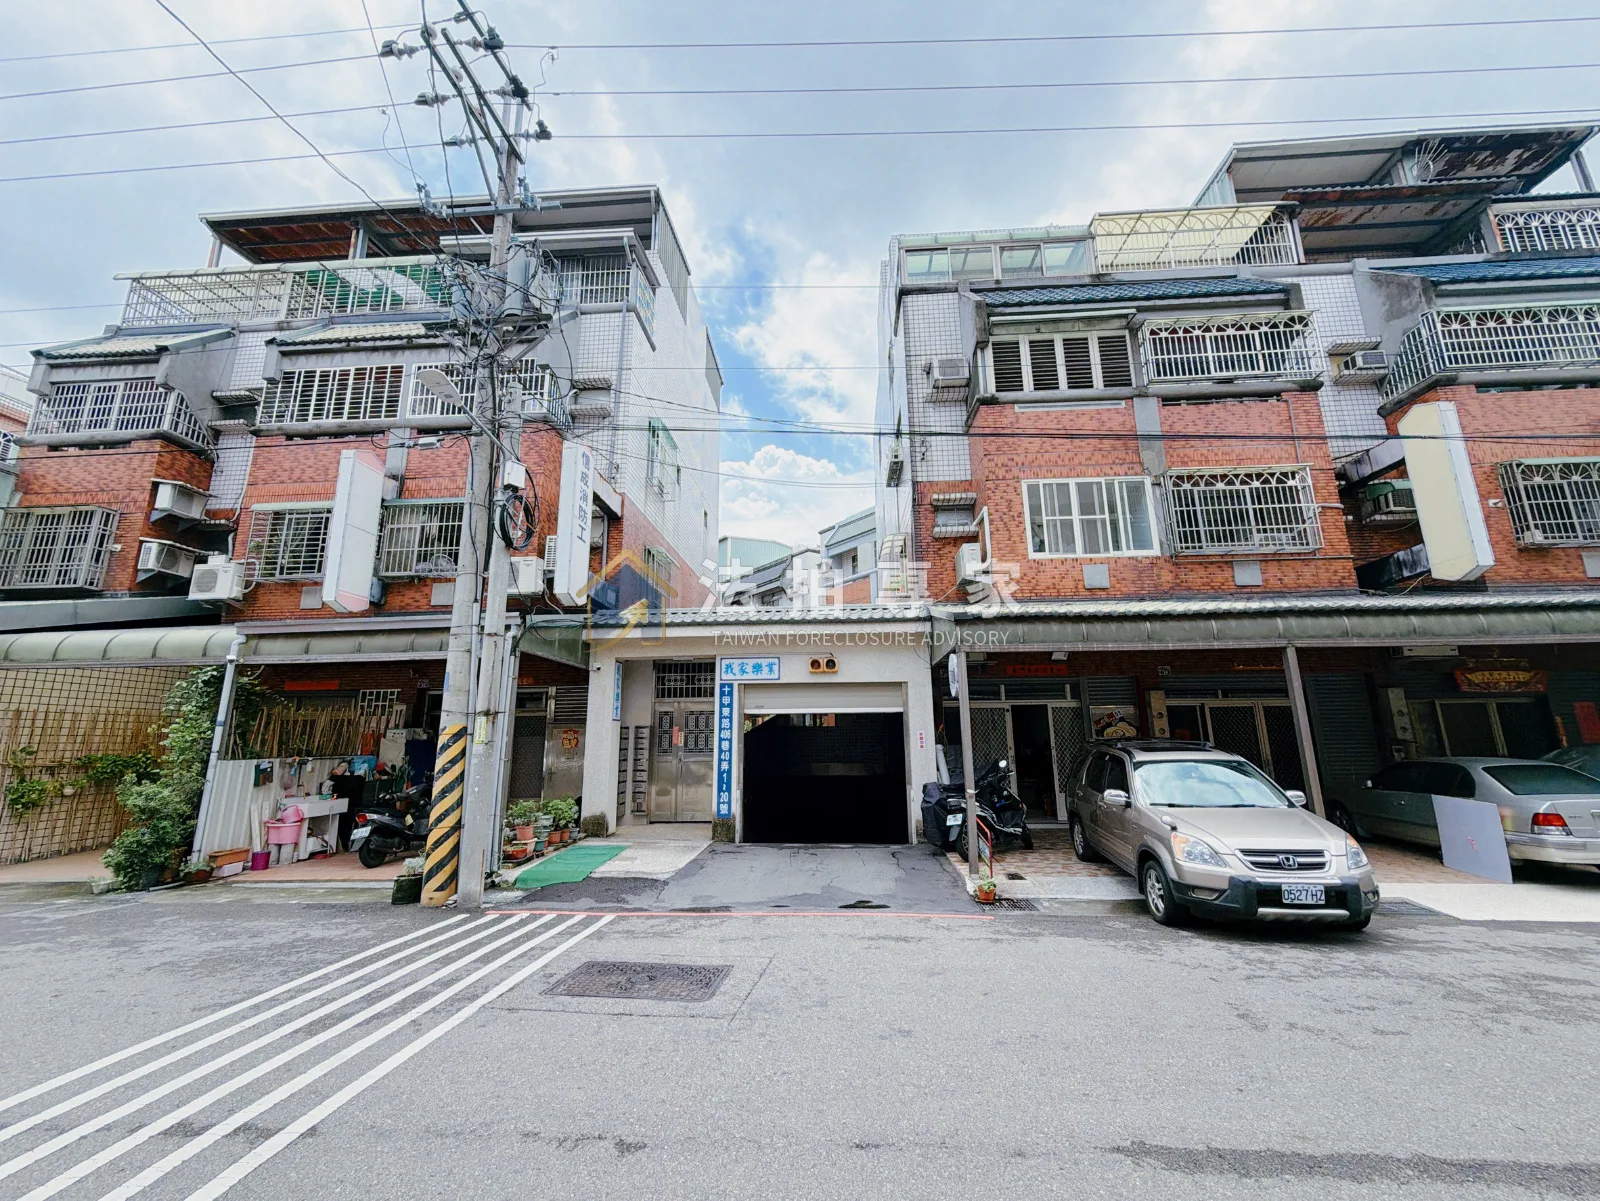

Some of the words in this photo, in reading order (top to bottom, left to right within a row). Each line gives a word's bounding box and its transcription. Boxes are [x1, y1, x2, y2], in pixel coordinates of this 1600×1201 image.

[577, 451, 591, 544] 信成消防工
[723, 661, 777, 676] 我家樂業
